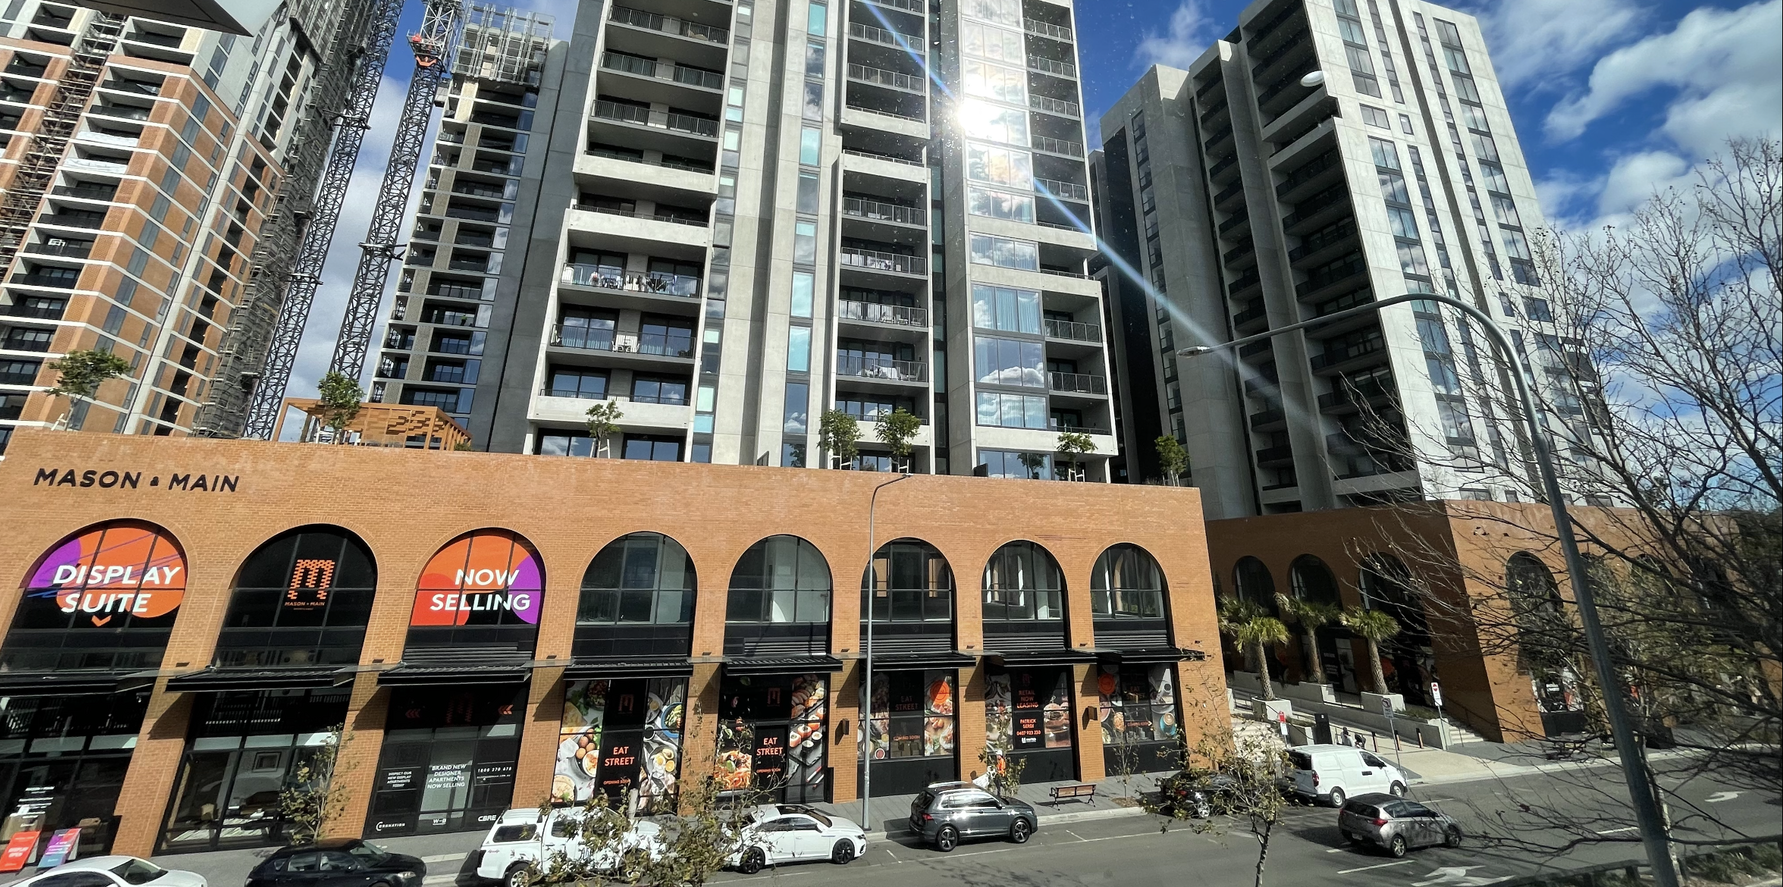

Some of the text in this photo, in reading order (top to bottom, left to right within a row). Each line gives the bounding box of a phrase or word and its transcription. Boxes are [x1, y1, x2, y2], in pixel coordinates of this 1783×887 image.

[33, 468, 142, 489] MASON
[168, 473, 240, 492] MAIN
[52, 564, 182, 585] DISPLAY
[454, 568, 520, 586] NOW
[60, 593, 152, 613] SUITE
[429, 593, 531, 611] SELLING
[613, 746, 629, 755] EAT
[756, 747, 783, 756] STREET
[604, 757, 635, 766] STREET
